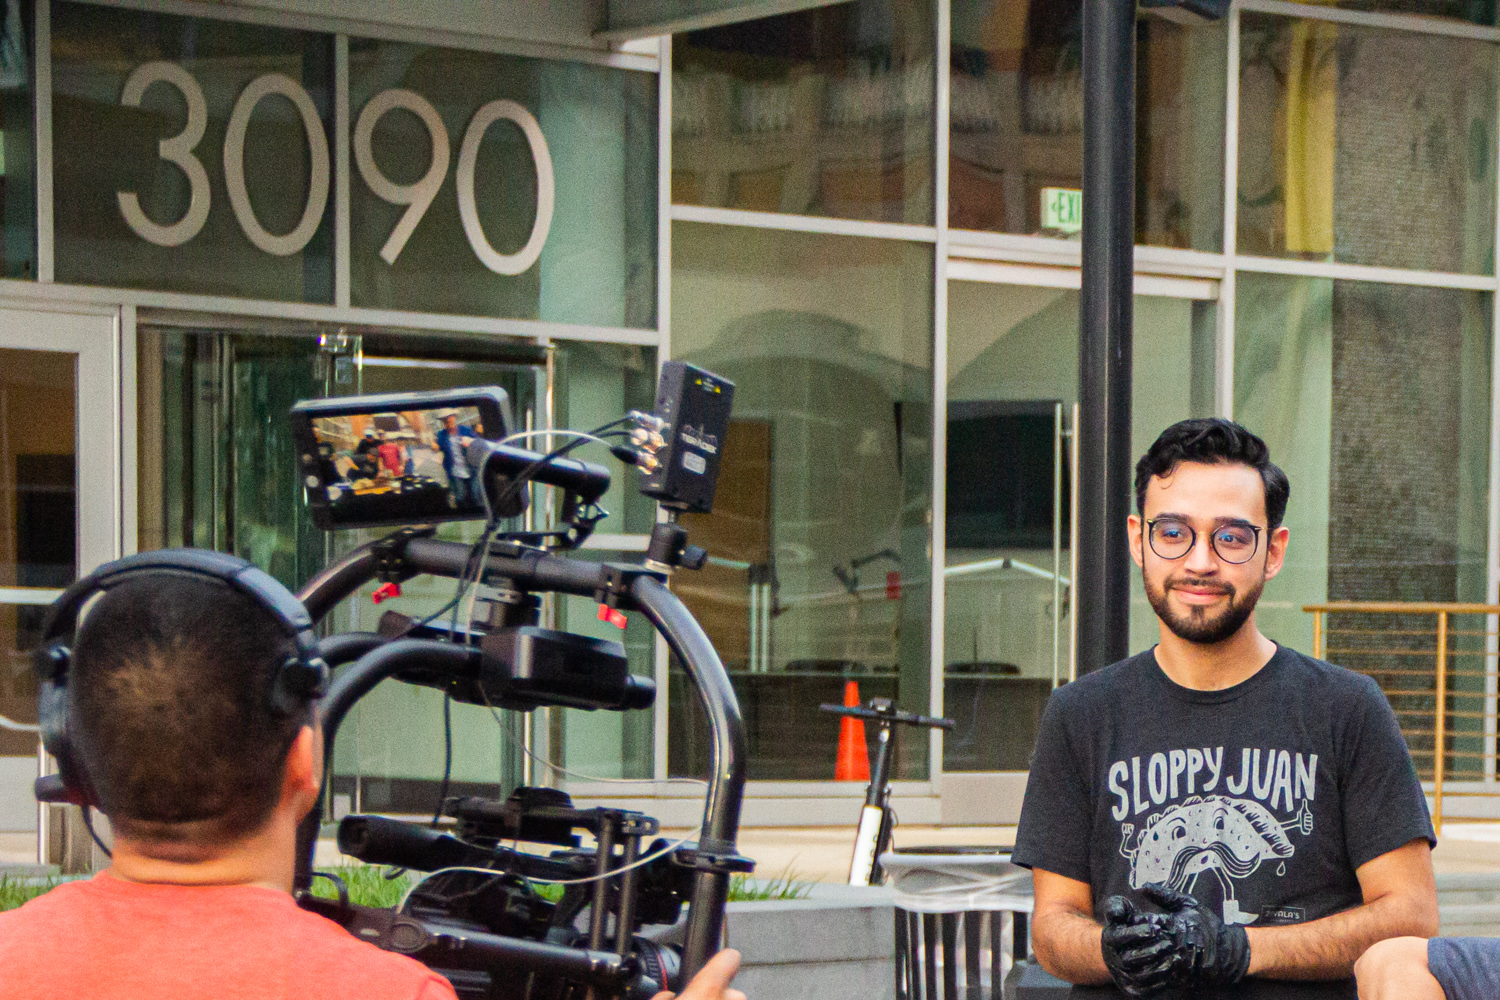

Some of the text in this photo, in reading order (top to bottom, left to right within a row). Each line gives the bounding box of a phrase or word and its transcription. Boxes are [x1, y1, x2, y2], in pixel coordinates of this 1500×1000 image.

[117, 60, 556, 276] 3090
[1057, 191, 1081, 224] EXI
[1108, 746, 1318, 822] SLOPPY JUAN
